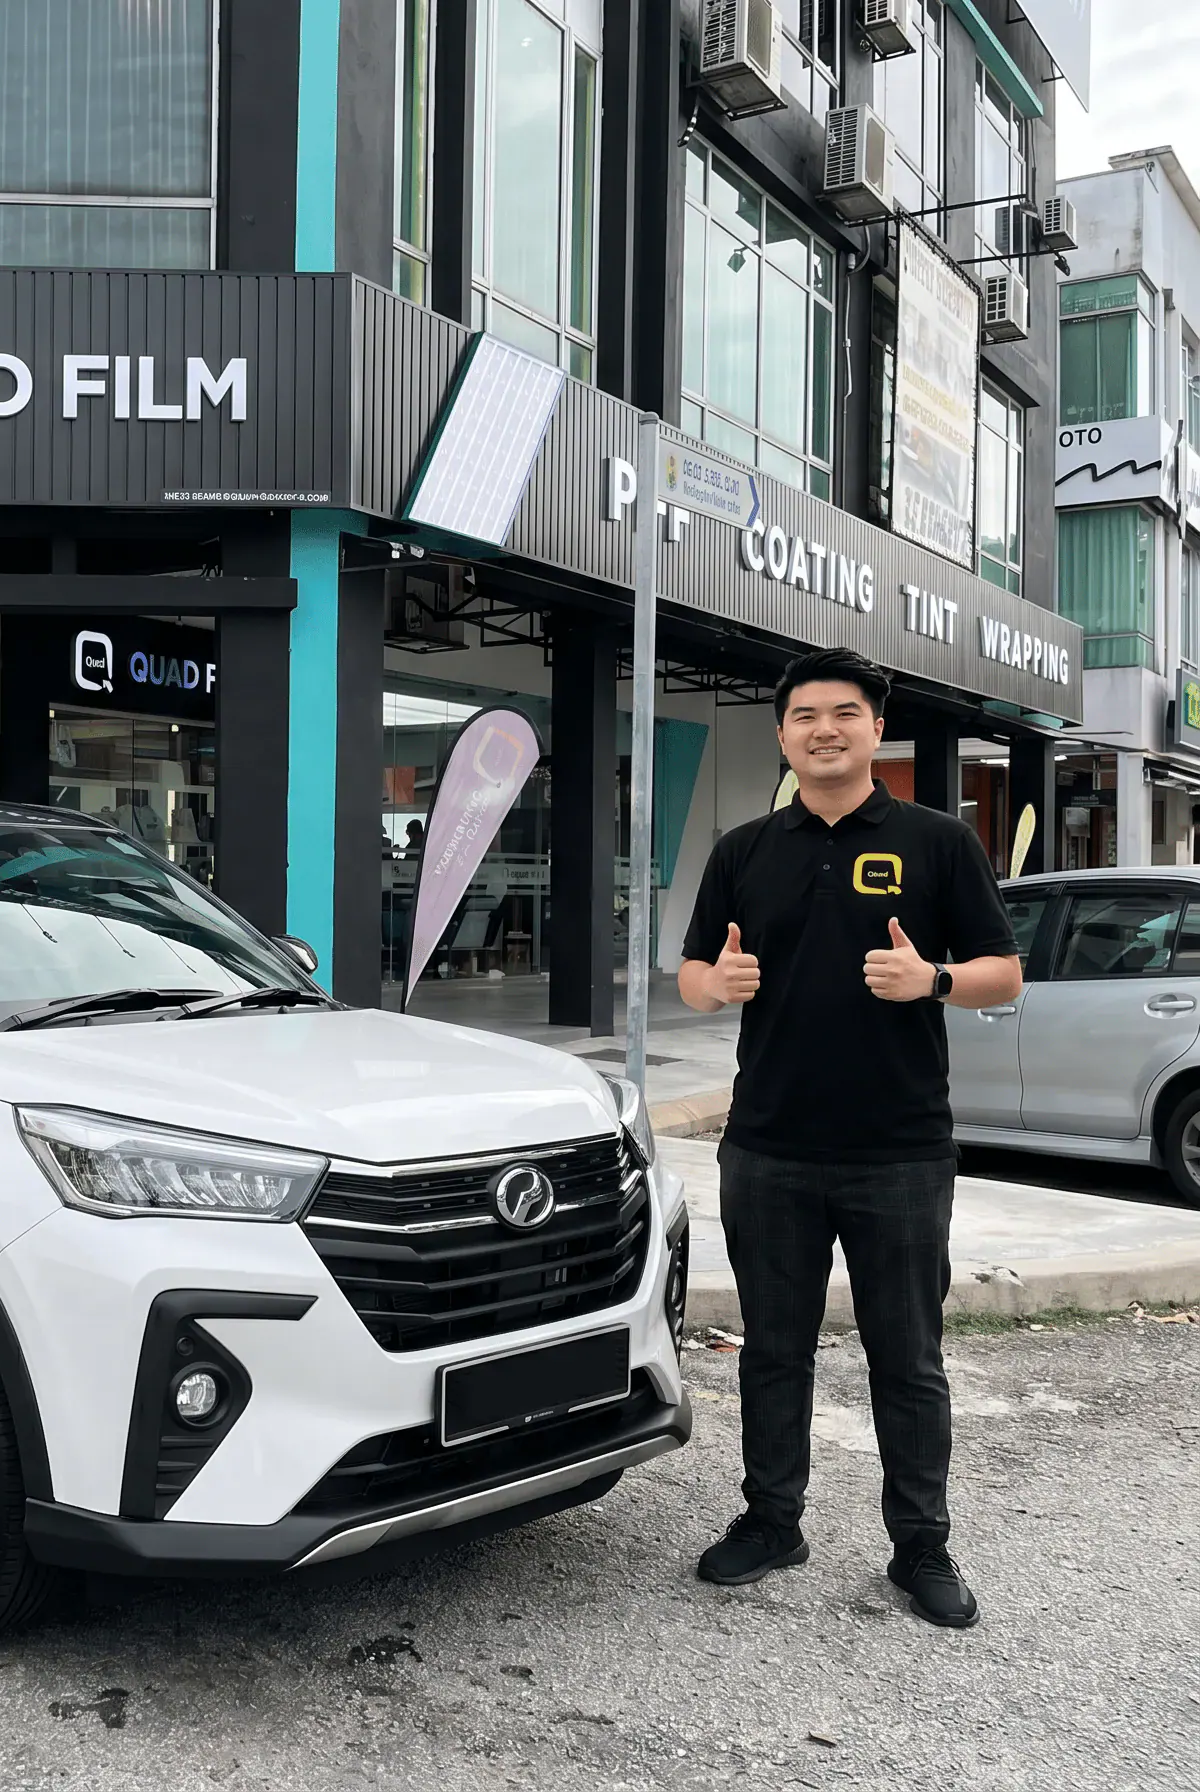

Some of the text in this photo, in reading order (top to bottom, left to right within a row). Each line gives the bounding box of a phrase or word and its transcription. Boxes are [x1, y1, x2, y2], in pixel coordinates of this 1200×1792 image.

[62, 353, 247, 422] FILM
[742, 518, 874, 613] COATING
[902, 583, 958, 645] TINT
[978, 615, 1068, 686] WRAPPING
[129, 651, 200, 690] QUAD
